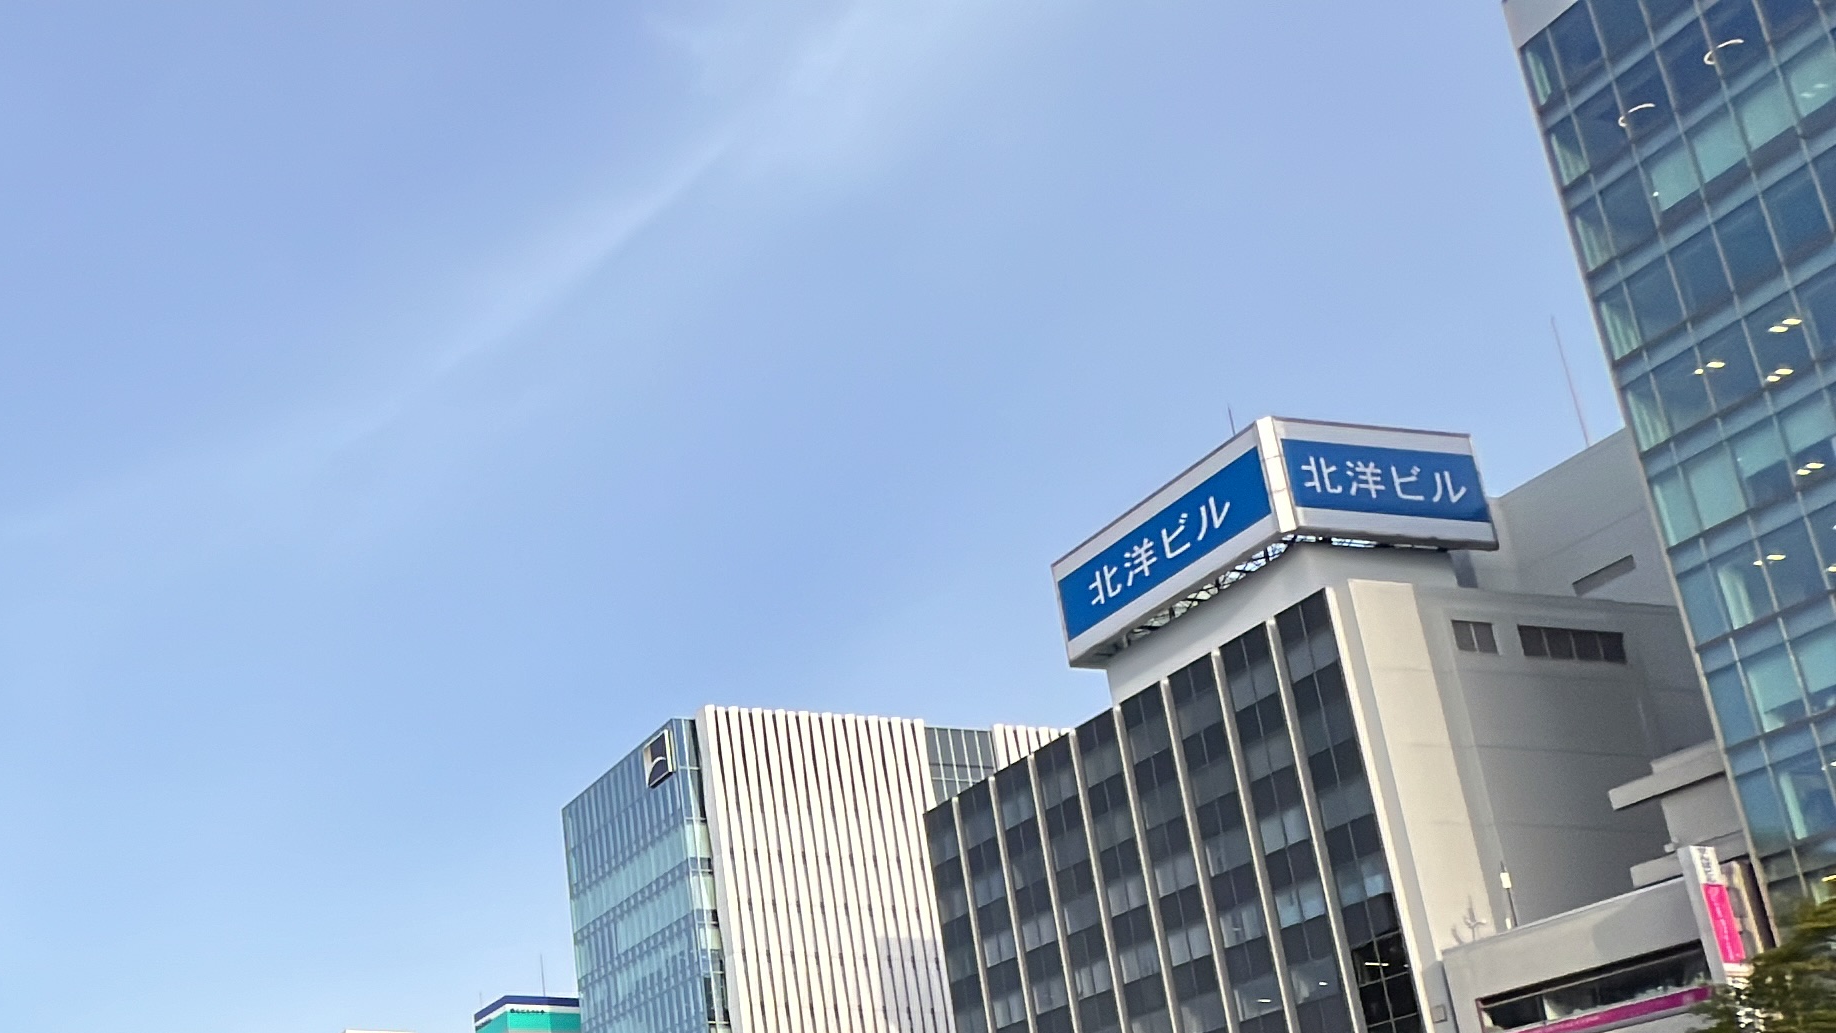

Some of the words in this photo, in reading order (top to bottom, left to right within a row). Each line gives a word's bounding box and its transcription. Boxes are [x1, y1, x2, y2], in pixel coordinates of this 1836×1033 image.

[1300, 455, 1467, 505] 北洋ビル
[1087, 495, 1231, 606] 北洋ビル
